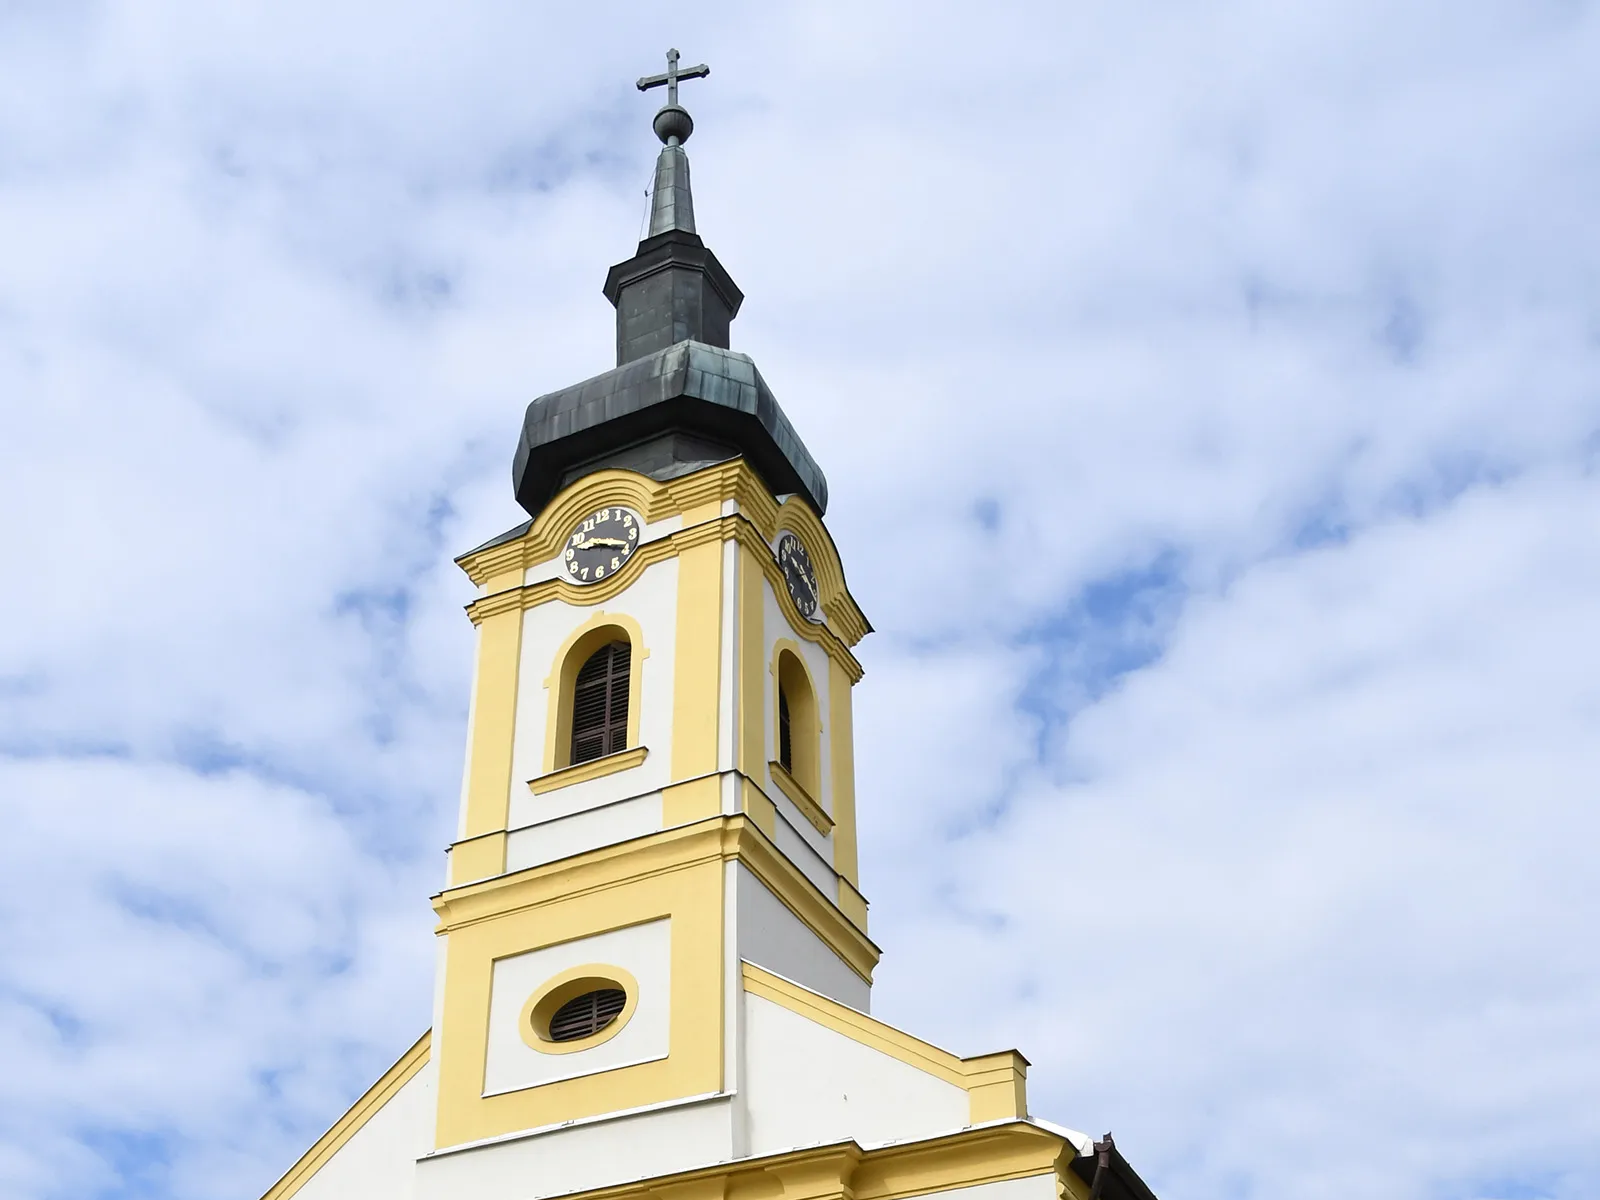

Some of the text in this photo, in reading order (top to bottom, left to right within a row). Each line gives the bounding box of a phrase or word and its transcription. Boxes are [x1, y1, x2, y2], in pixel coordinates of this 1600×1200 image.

[595, 509, 610, 524] 12
[614, 510, 621, 521] 1
[623, 514, 632, 528] 2
[583, 518, 595, 532] 11
[571, 532, 585, 546] 10
[628, 528, 637, 540] 3
[621, 543, 629, 555] 4
[784, 539, 791, 555] 10
[790, 536, 796, 552] 11
[797, 540, 804, 556] 12
[565, 549, 575, 561] 9
[570, 561, 578, 573] 8
[611, 557, 619, 569] 5
[580, 567, 589, 580] 7
[595, 565, 604, 578] 6
[790, 583, 795, 594] 7
[797, 597, 802, 609] 6
[804, 601, 809, 614] 5
